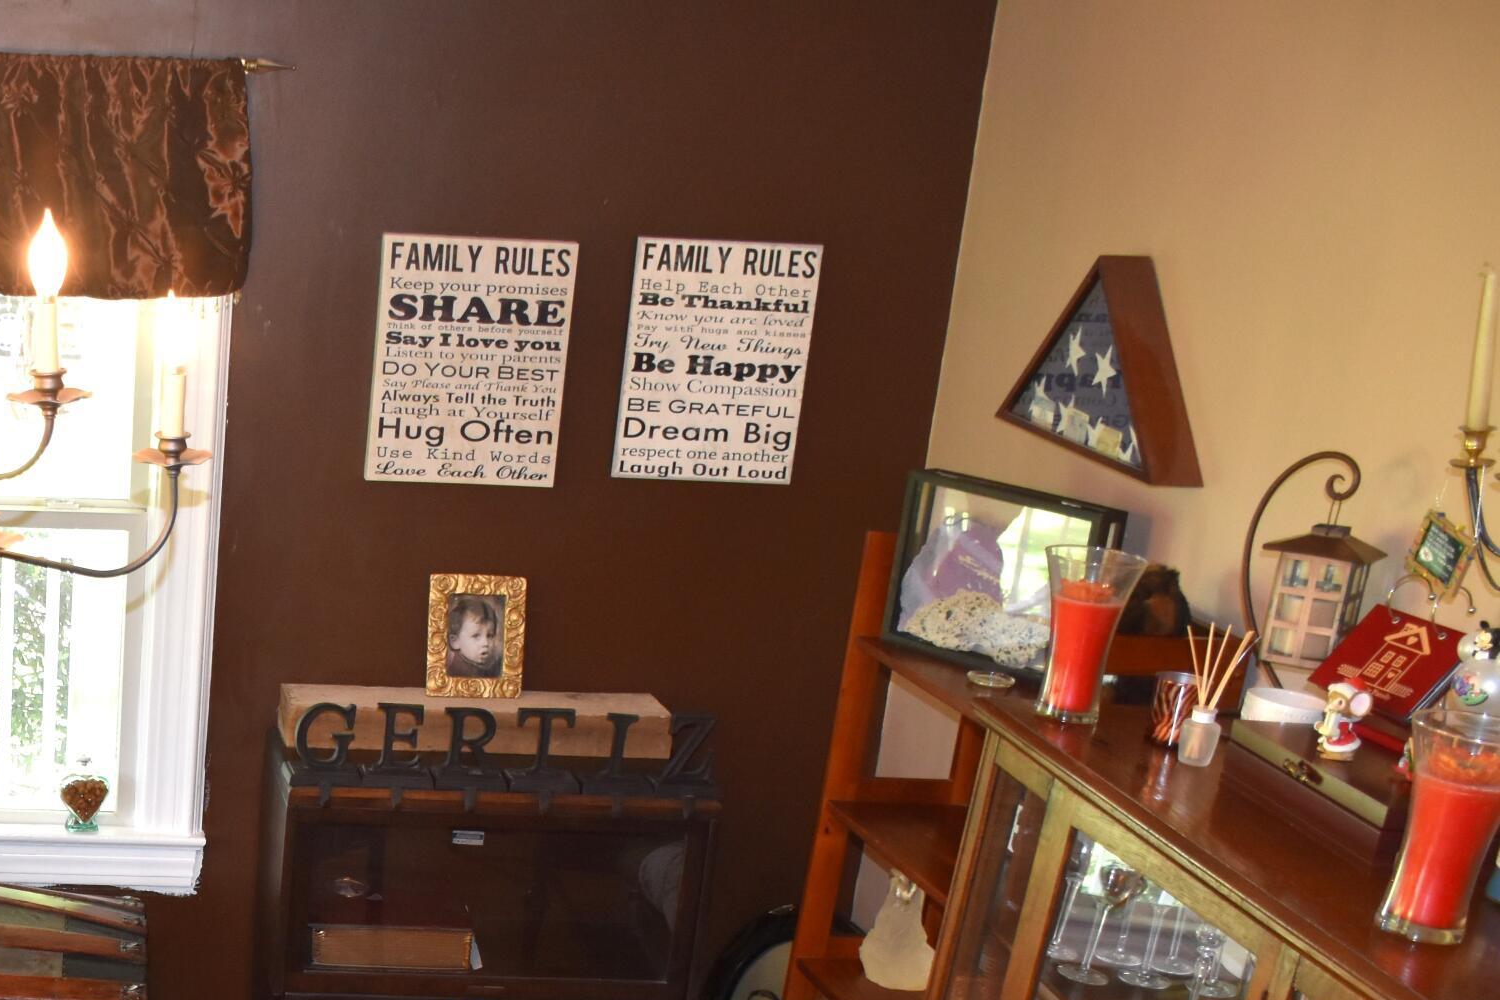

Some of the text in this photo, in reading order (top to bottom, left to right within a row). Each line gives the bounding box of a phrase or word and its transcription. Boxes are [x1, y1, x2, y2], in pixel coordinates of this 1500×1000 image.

[391, 242, 571, 276] FAMILY RULES
[642, 243, 817, 278] FAMILY RULES
[390, 277, 568, 296] Keep your promises
[641, 279, 811, 298] Help Each Other
[388, 294, 565, 327] SHARE
[639, 292, 810, 313] Be Thankful
[386, 331, 561, 352] Say I love you
[635, 334, 803, 359] Try New Things
[386, 347, 561, 365] Listen to your parents
[632, 352, 802, 383] Be Happy
[381, 390, 555, 407] Always Tell the Truth
[629, 377, 797, 399] Show Compassion
[381, 403, 554, 421] Laugh at Yourself
[377, 417, 552, 446] Hug Often
[624, 417, 792, 451] Dream Big
[377, 447, 550, 464] Use Kind Words
[621, 447, 788, 463] respect one another
[376, 462, 548, 481] Love Each Other
[619, 461, 786, 480] Laugh Out Loud
